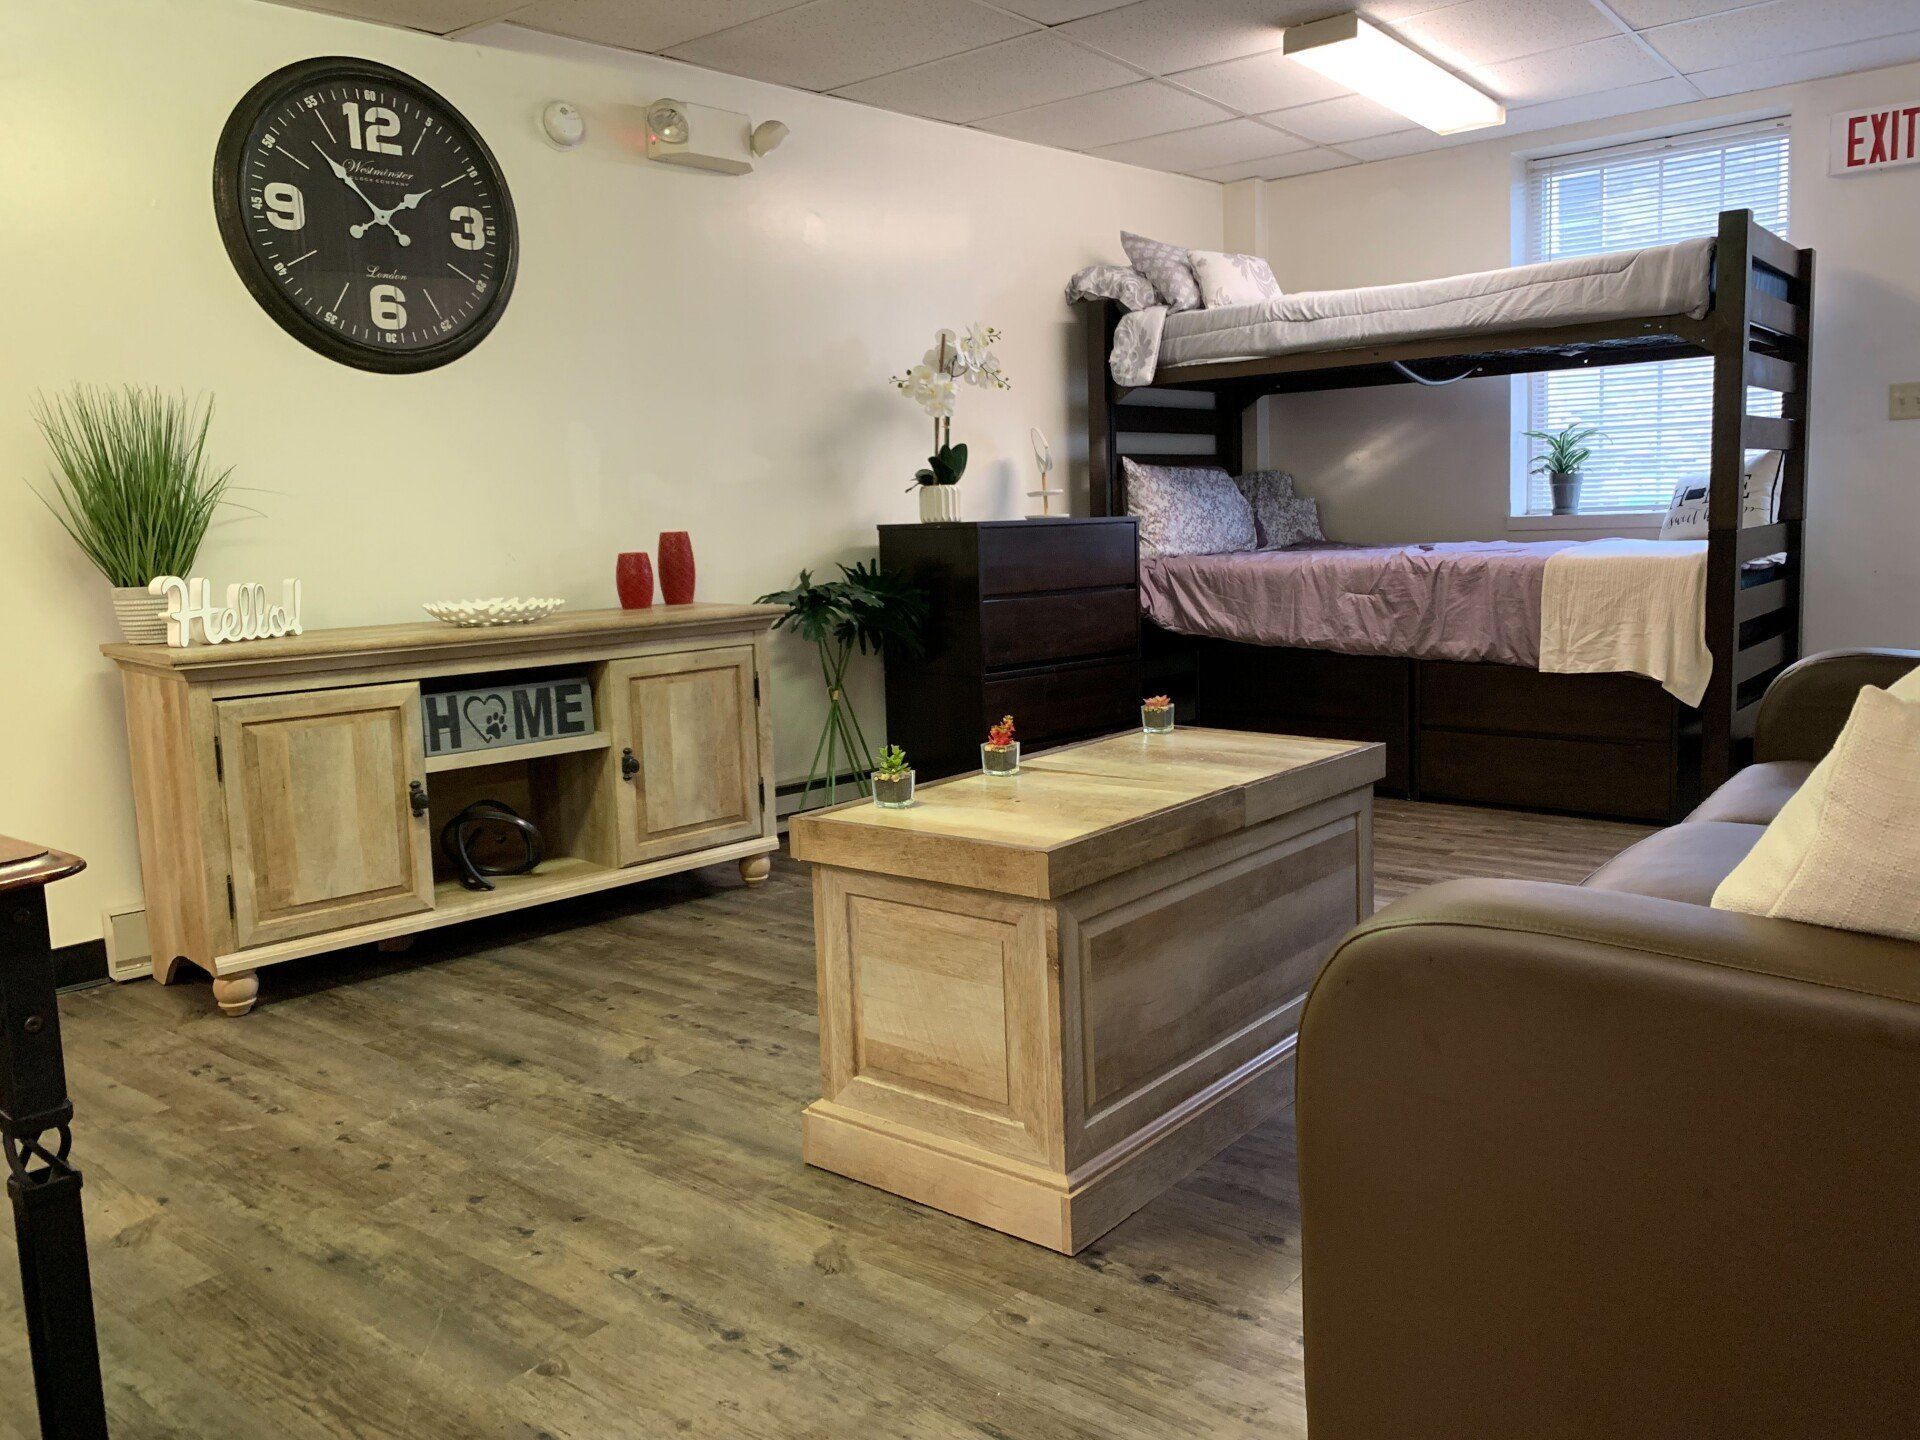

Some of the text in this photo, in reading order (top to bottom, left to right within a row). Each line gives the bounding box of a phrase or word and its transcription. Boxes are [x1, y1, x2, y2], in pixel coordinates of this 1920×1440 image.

[304, 95, 318, 109] 55
[342, 102, 403, 156] 12
[425, 117, 434, 127] 5
[262, 133, 276, 148] 50
[1847, 107, 1920, 167] EXIT
[342, 159, 414, 180] Westminster
[467, 165, 478, 178] 10
[251, 197, 263, 210] 45
[264, 182, 305, 231] 9
[450, 205, 486, 250] 3
[486, 225, 496, 236] 15
[366, 265, 407, 280] London
[370, 284, 408, 330] 6
[324, 311, 338, 325] 35
